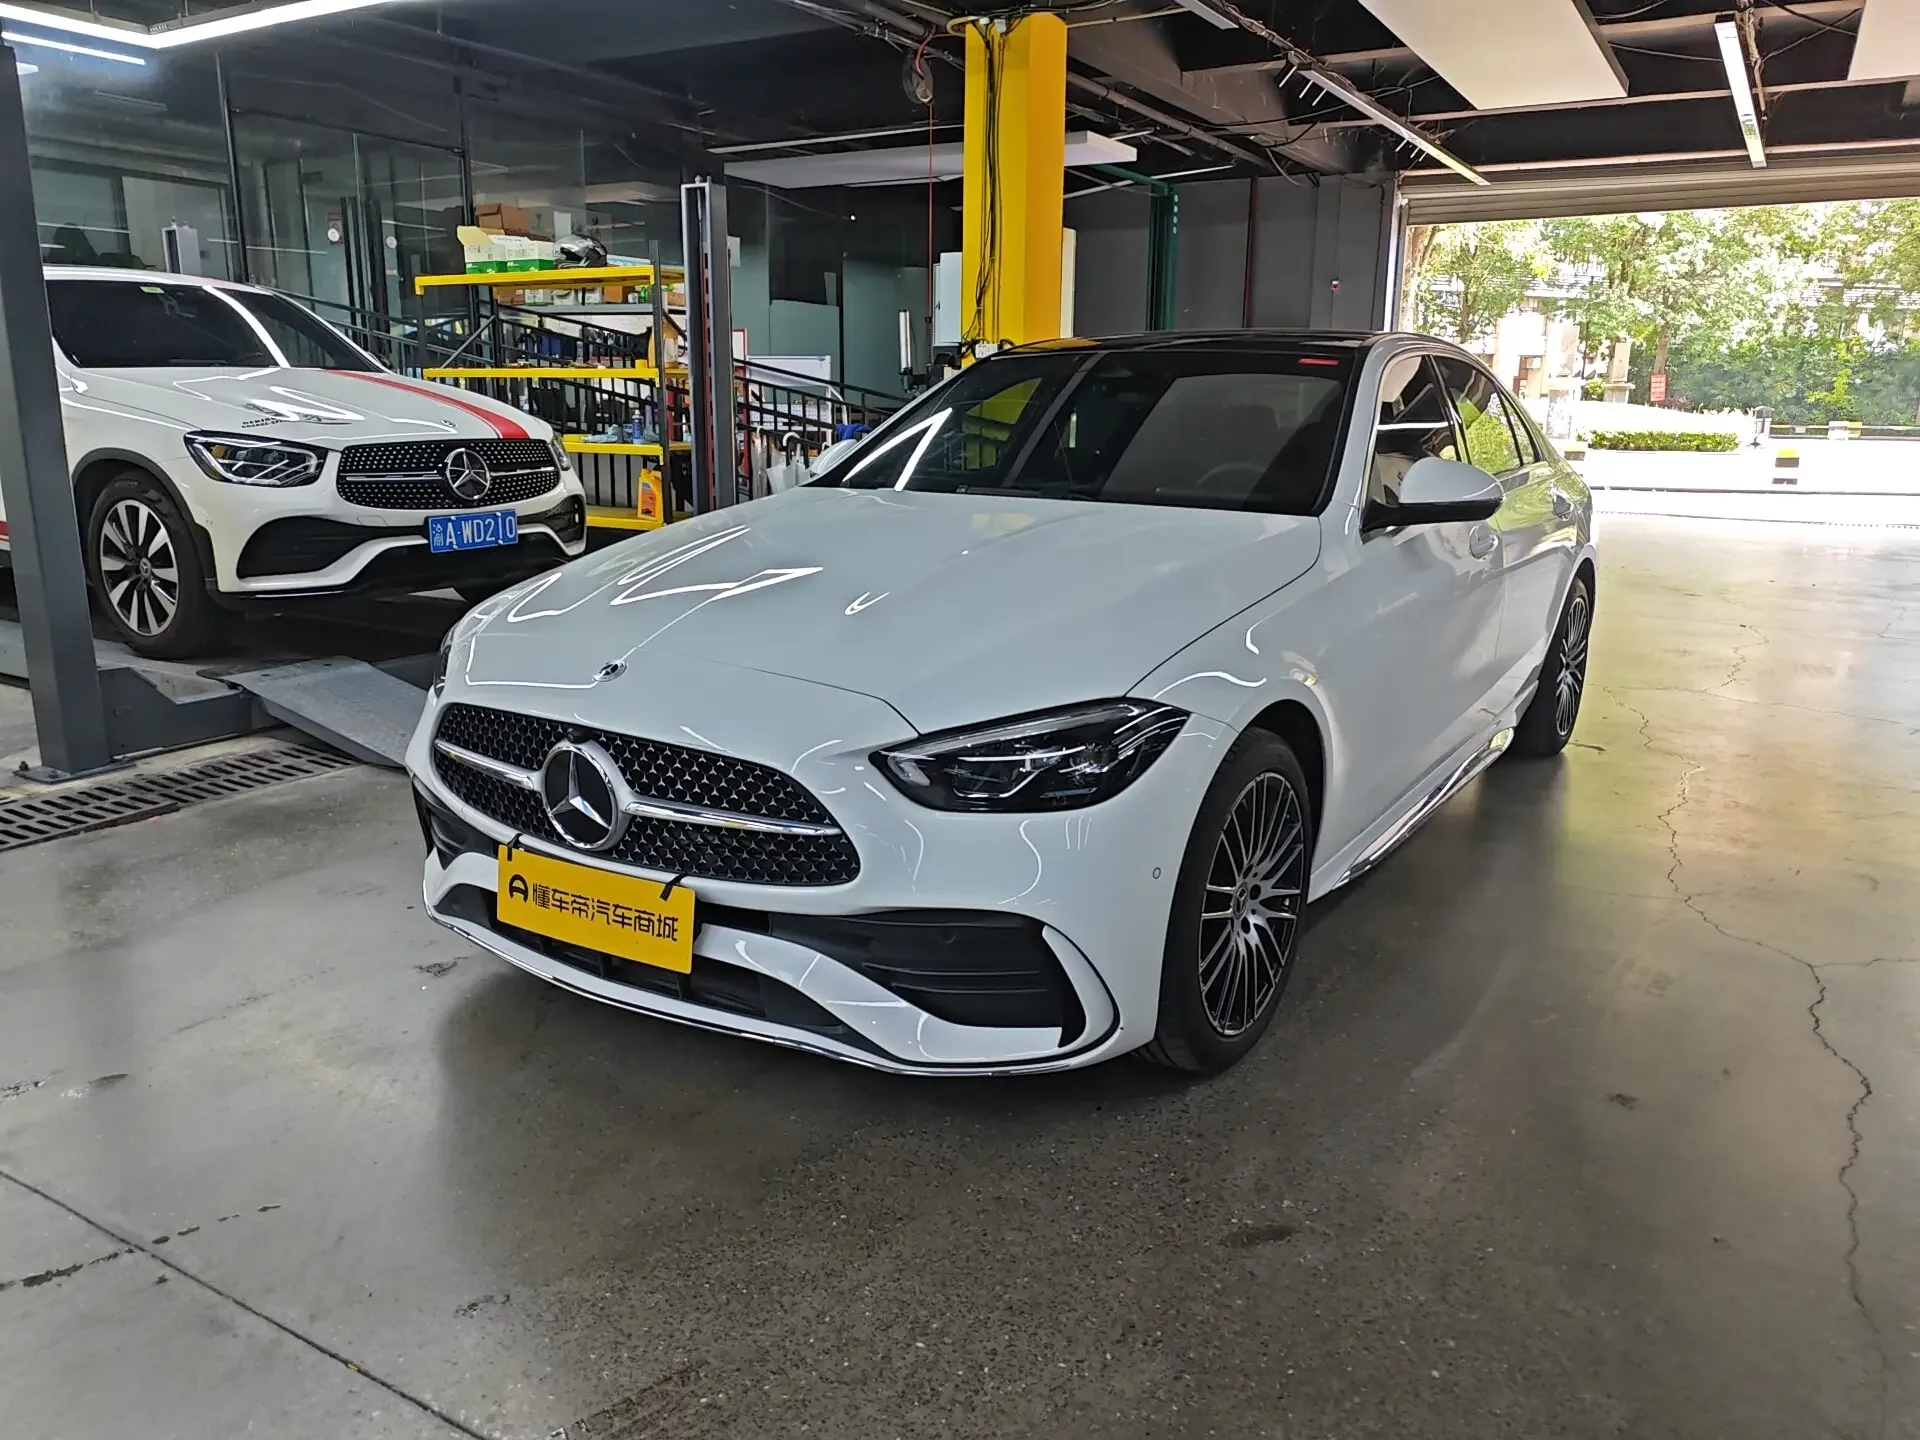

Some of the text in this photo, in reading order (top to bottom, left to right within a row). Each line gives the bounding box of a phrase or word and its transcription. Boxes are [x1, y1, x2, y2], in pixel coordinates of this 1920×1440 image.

[532, 883, 679, 942] 懂车帝汽车商城
